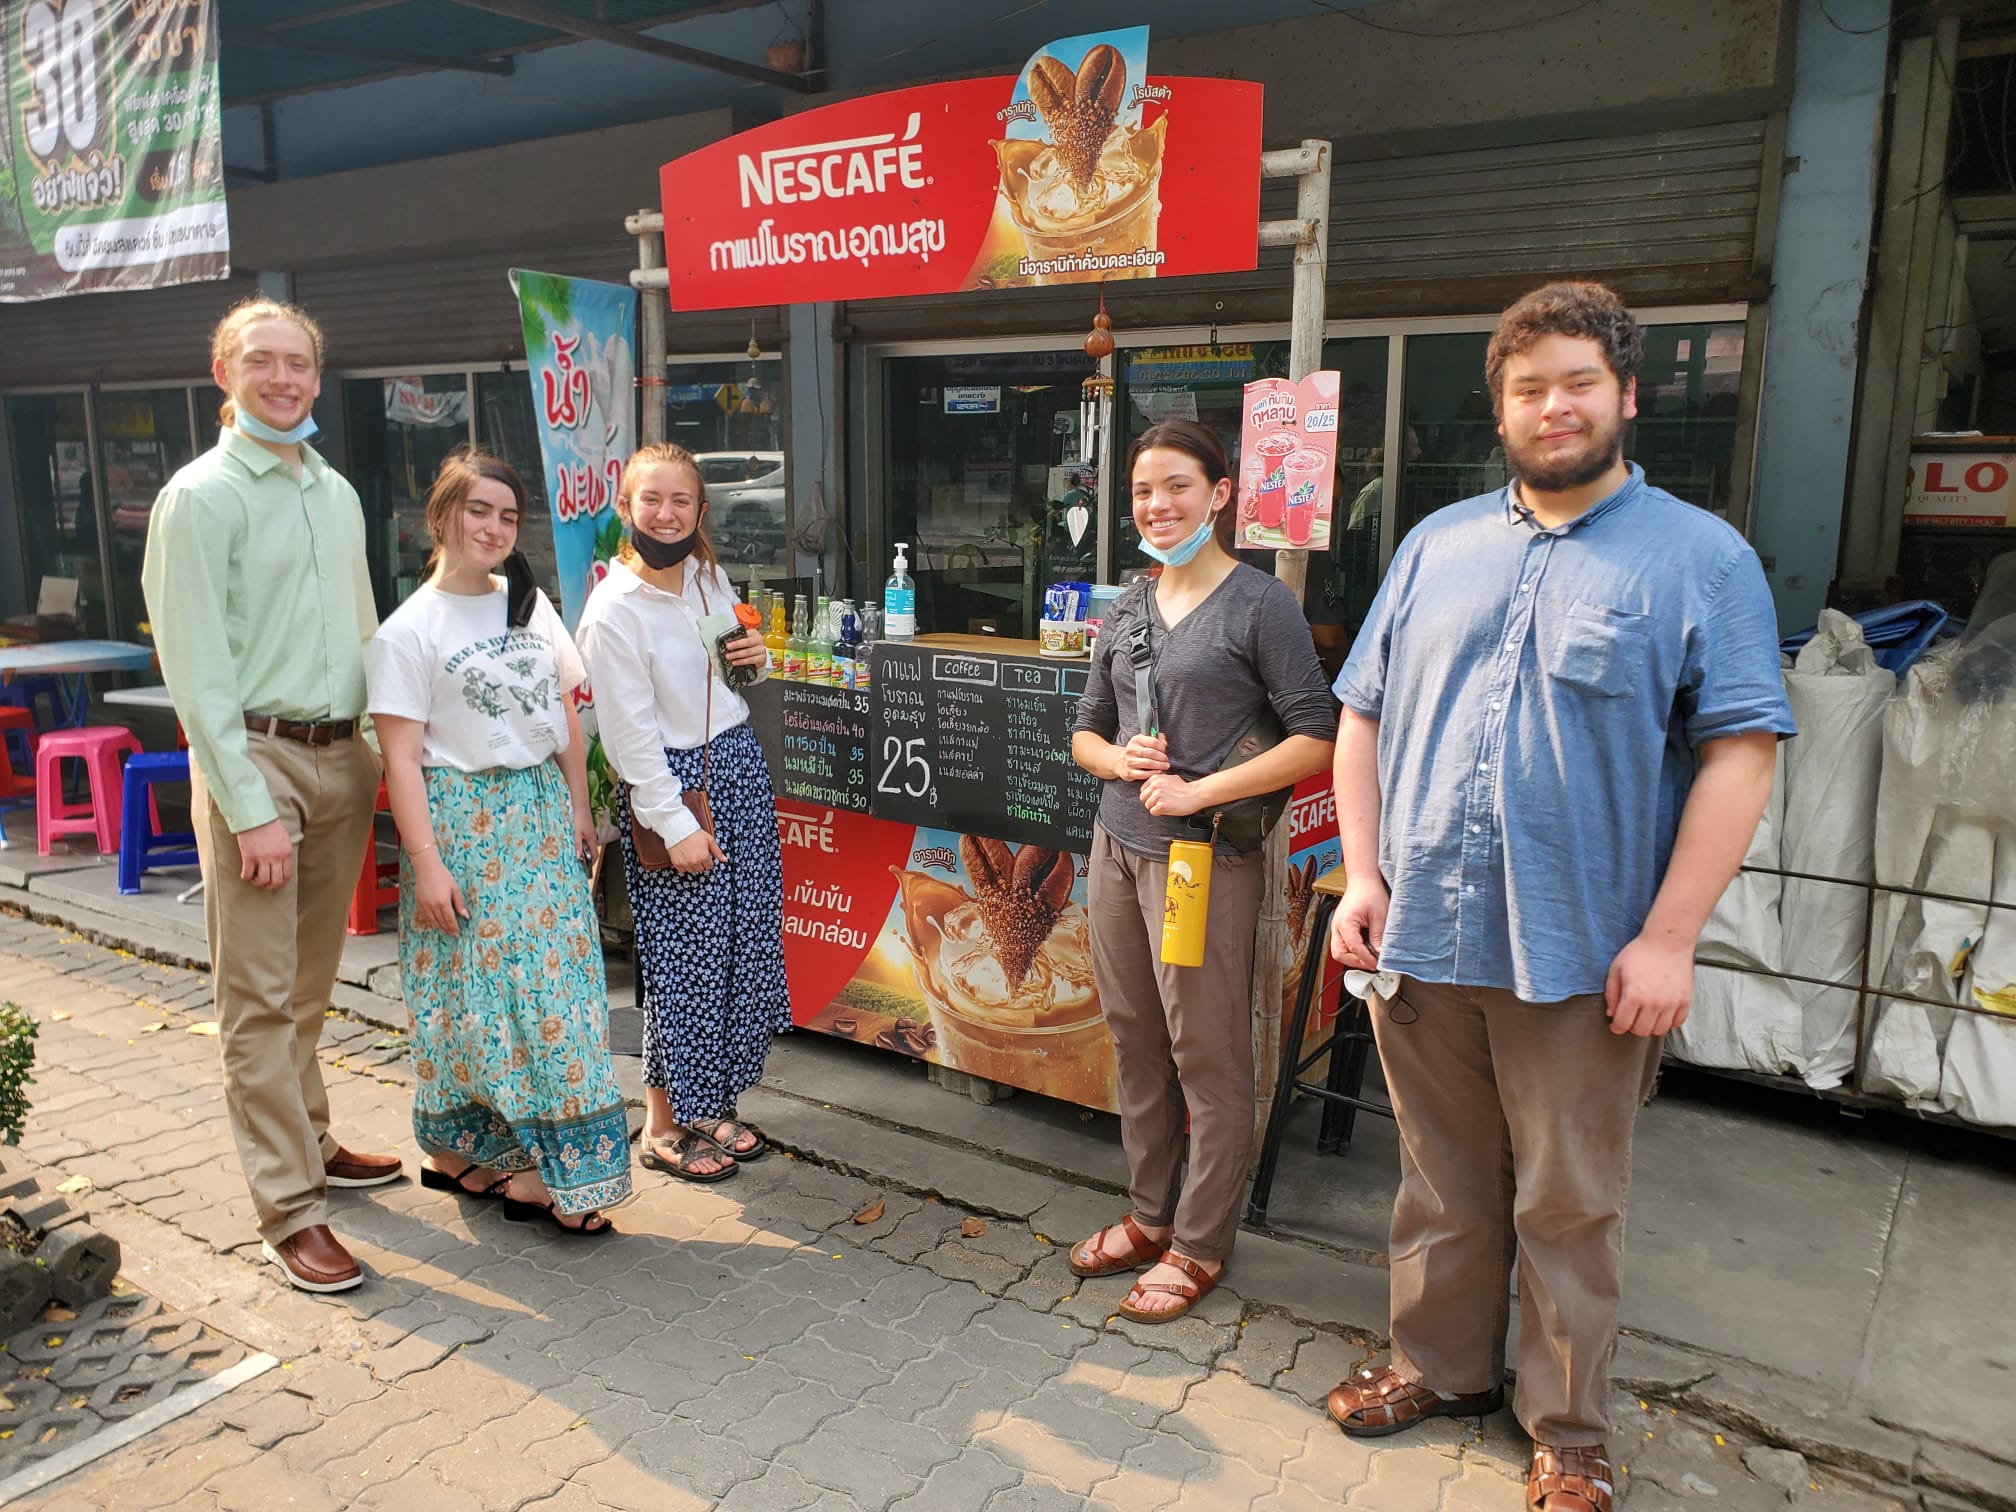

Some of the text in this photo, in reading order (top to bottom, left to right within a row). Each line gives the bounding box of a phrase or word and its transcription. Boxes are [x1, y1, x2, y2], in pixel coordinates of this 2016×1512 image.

[24, 0, 97, 155] 30
[1133, 84, 1172, 101] โรบัสต้า
[996, 101, 1036, 121] อาราบิก้า
[738, 112, 926, 208] NESCAFÉ
[1018, 247, 1165, 277] มีอาราบิก้าคั่วบดละเอียด
[542, 331, 591, 429] น้ำ
[1252, 406, 1296, 430] กุหลาบ
[1306, 411, 1335, 429] 20/25
[1288, 492, 1315, 507] NESTEA
[1918, 495, 1968, 504] QUALITY
[444, 645, 475, 674] BEE
[881, 656, 920, 682] กาแฟ
[1013, 668, 1042, 684] Tea
[881, 684, 925, 706] โบราณ
[937, 687, 984, 704] กาแฟโบราณ
[854, 695, 869, 714] 35
[883, 707, 926, 729] อุดมสุข
[1007, 711, 1037, 728] ชาเขียว
[852, 723, 865, 738] 40
[938, 733, 979, 750] เนสกาแฟ
[850, 746, 864, 761] 35
[1007, 744, 1051, 761] ชามะนาว
[877, 736, 931, 797] 25
[1006, 757, 1042, 774] ชาเนส
[848, 769, 864, 785] 35
[851, 793, 867, 808] 30
[913, 848, 956, 866] อาราบิก้า
